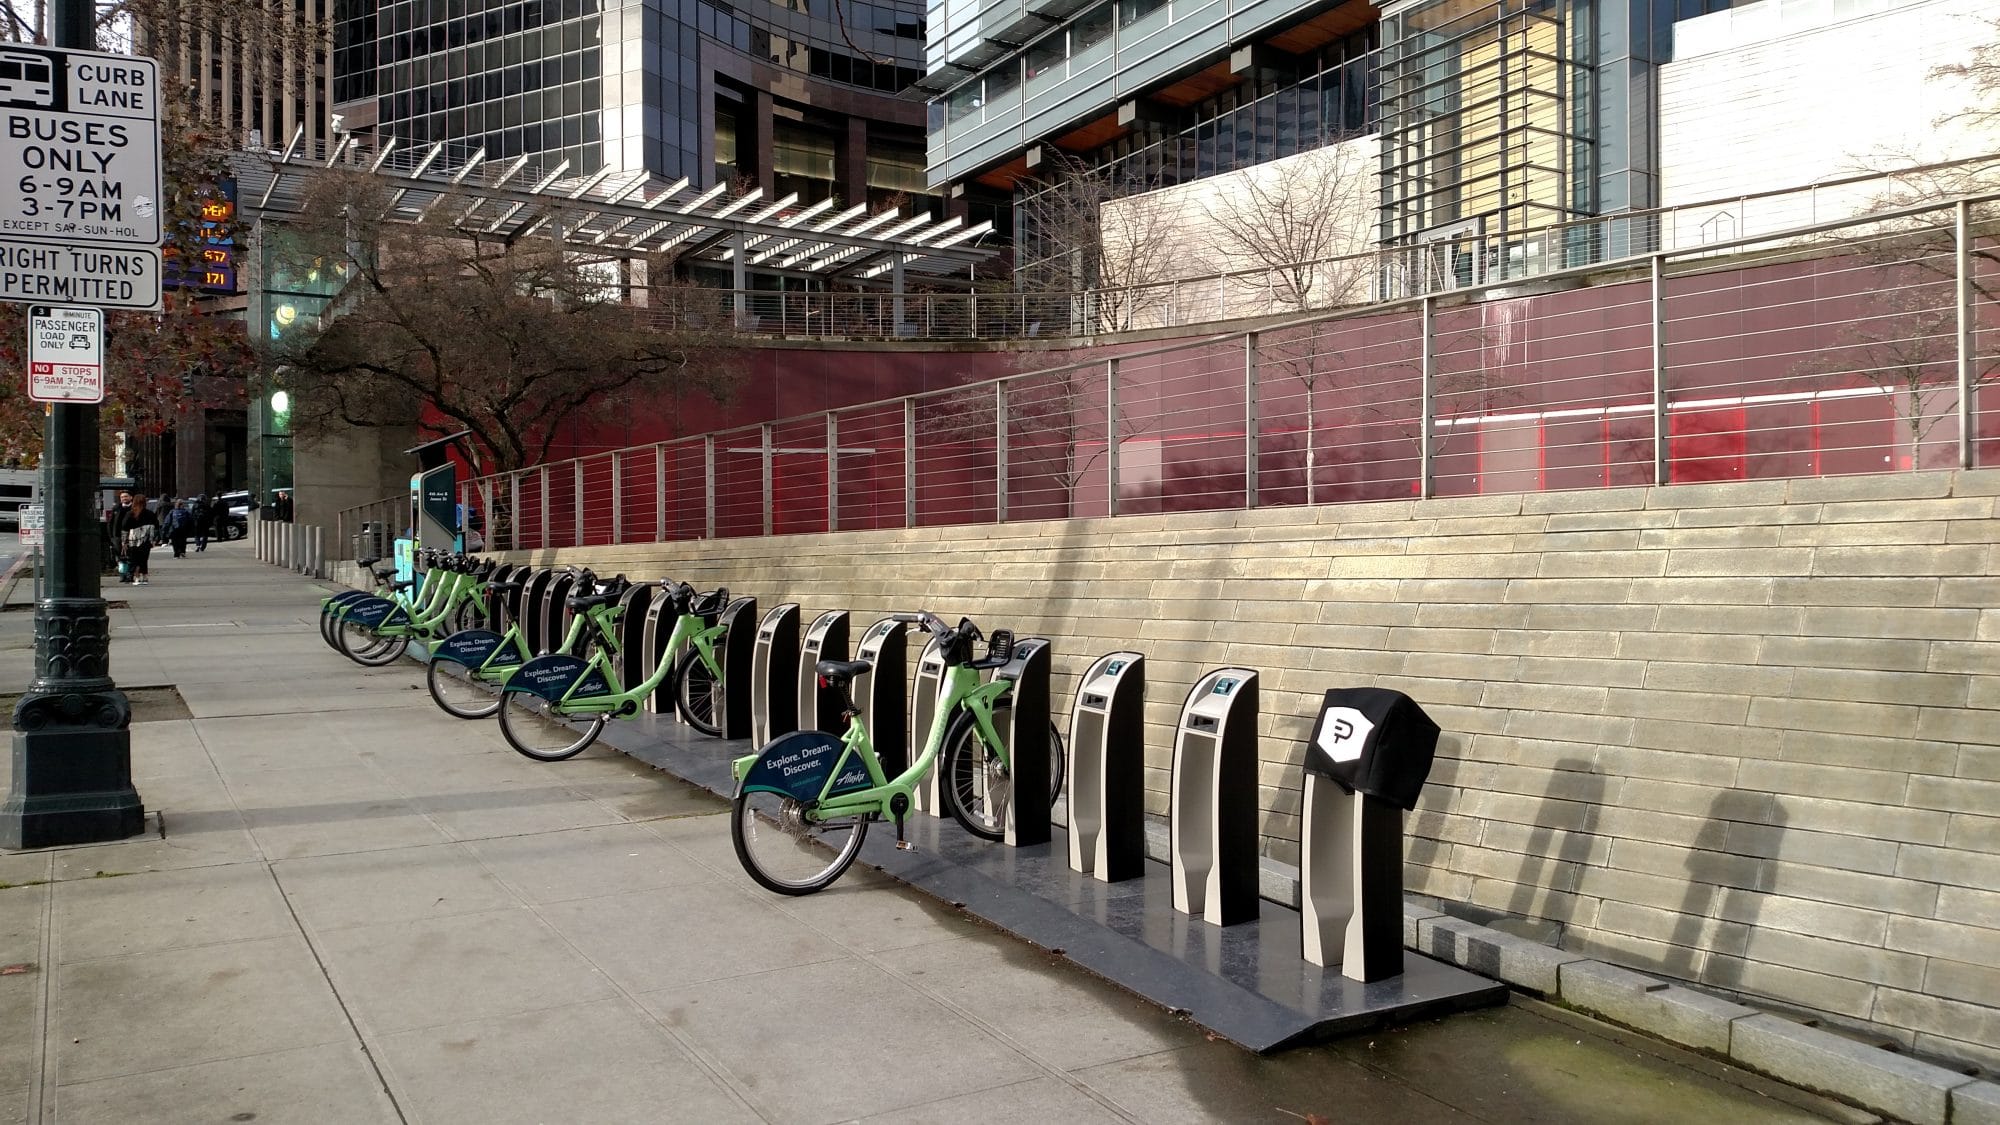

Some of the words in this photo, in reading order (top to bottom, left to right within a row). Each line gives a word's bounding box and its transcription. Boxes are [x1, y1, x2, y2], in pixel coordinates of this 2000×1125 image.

[77, 64, 145, 87] CURB
[79, 87, 144, 110] LANE
[9, 115, 129, 148] BUSES
[23, 145, 116, 174] ONLY
[19, 175, 122, 200] 6-9AM
[22, 197, 122, 222] 3-7PM
[3, 219, 49, 232] EXCEPT
[70, 252, 144, 277] TURNS
[4, 272, 133, 299] PERMITTED
[206, 272, 224, 285] 171
[35, 319, 96, 332] PASSENGER
[40, 331, 65, 341] LOAD
[40, 340, 65, 349] ONLY
[34, 364, 49, 373] NO
[61, 367, 92, 376] STOPS
[33, 376, 64, 385] 6-9AM
[449, 640, 474, 649] Explore.
[474, 637, 496, 646] Dream.
[460, 644, 487, 653] Discover.
[524, 668, 552, 679] Explore.
[553, 662, 578, 674] Dream.
[537, 673, 569, 684] Discover.
[766, 753, 801, 770] Explore.
[801, 744, 832, 758] Dream.
[783, 759, 822, 777] Discover.
[836, 770, 866, 785] Alaska
